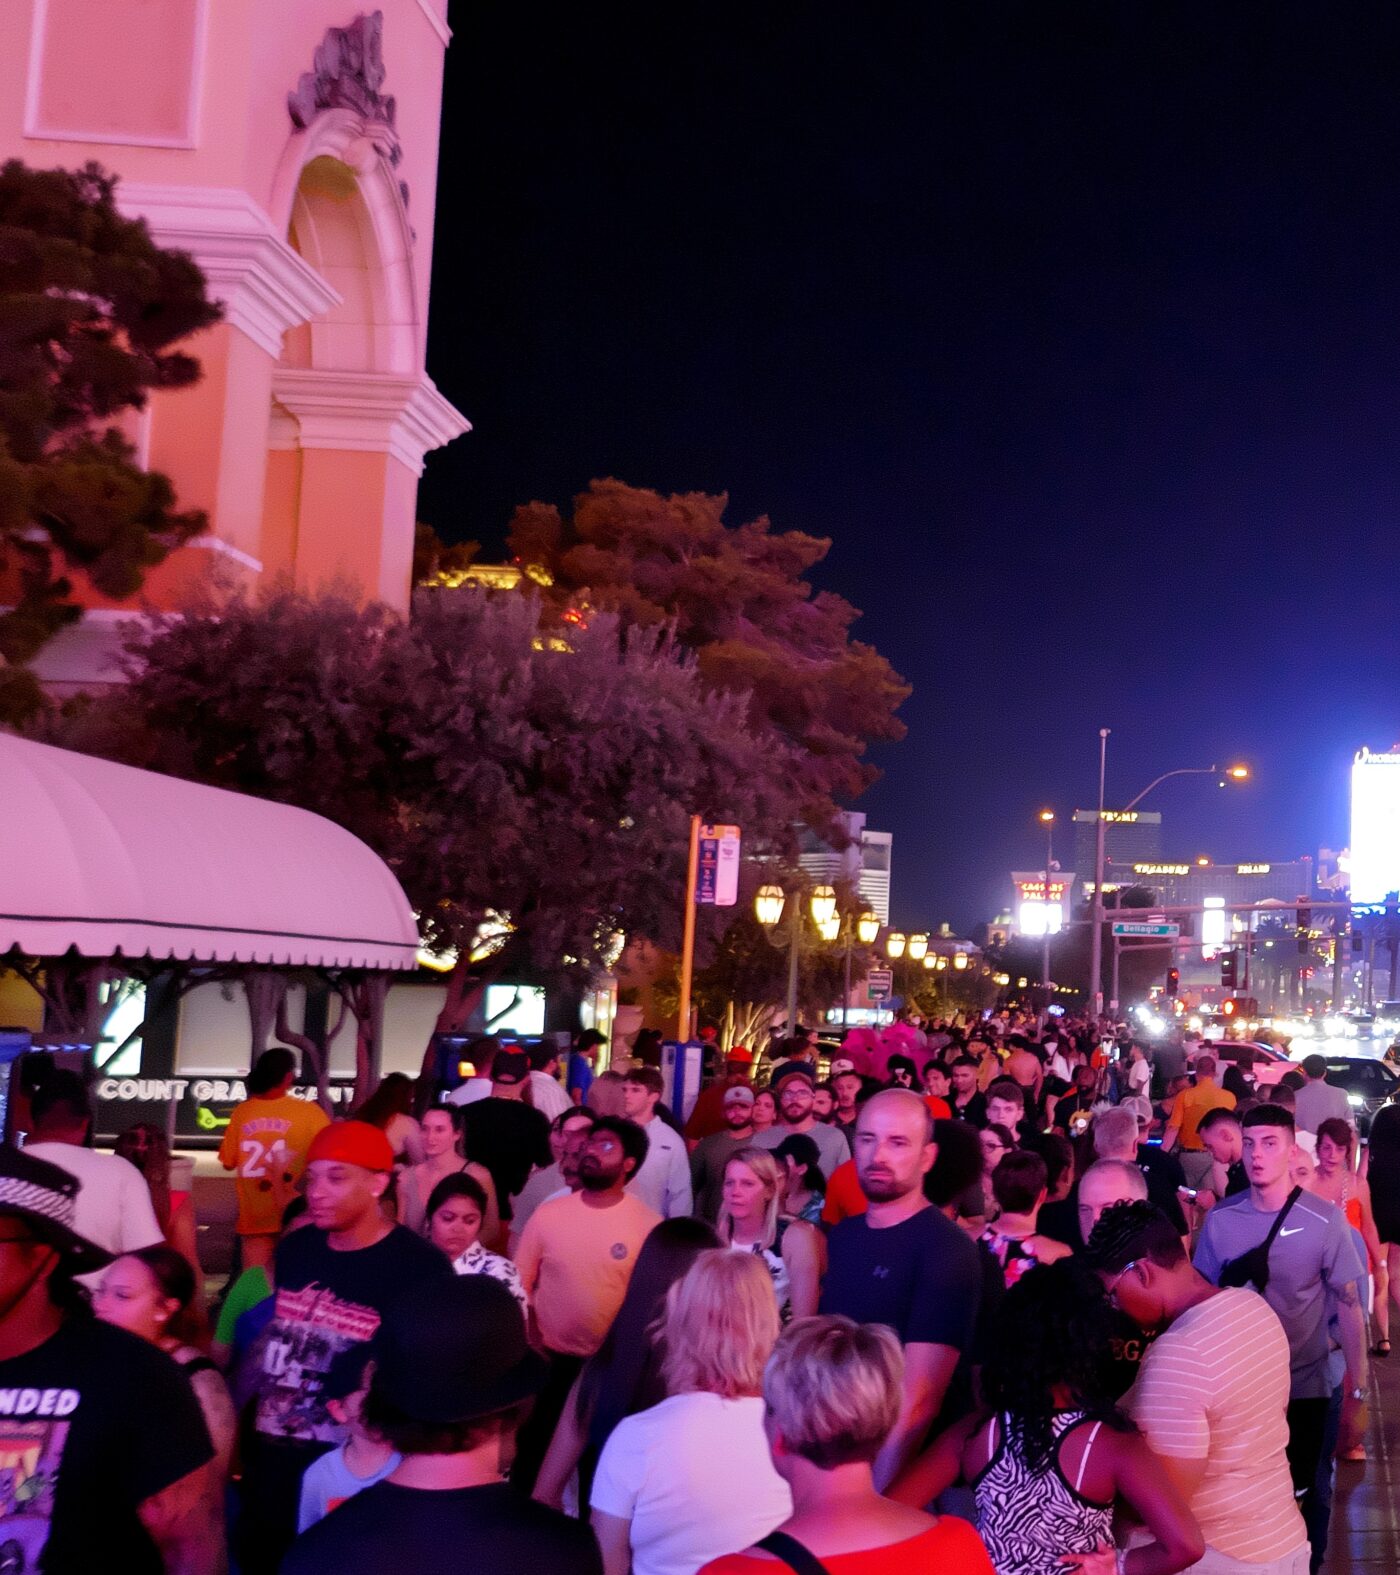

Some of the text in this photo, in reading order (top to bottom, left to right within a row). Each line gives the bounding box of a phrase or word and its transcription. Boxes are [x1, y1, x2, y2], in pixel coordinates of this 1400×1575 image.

[1100, 811, 1138, 822] TRUMP
[1134, 864, 1190, 875] TREASURE
[1123, 924, 1160, 934] Bellagio
[99, 1079, 189, 1101] COUNT
[193, 1080, 248, 1101] GRA
